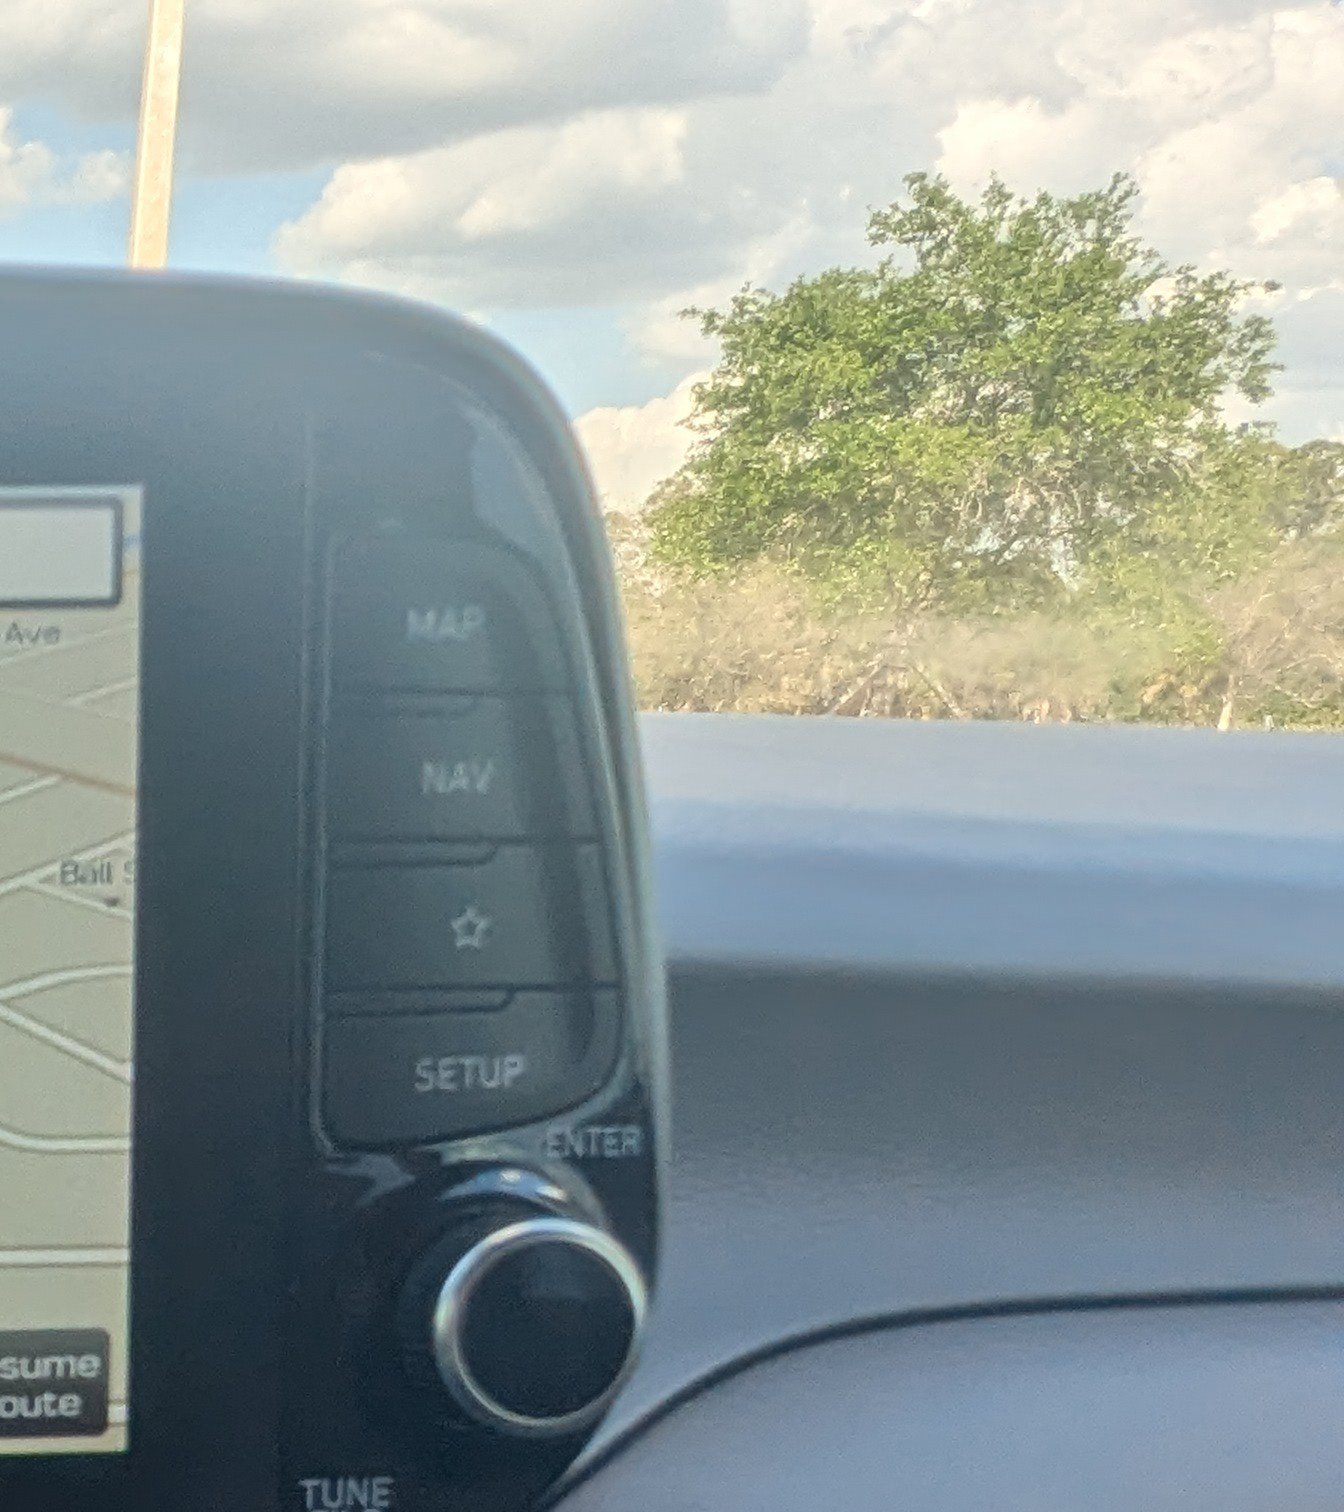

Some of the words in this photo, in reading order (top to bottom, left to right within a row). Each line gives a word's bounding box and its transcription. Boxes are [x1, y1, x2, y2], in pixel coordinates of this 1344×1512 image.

[5, 621, 60, 646] Ave
[407, 607, 485, 642] MAP
[420, 760, 495, 795] NAV
[413, 1056, 526, 1093] SETUP
[546, 1125, 641, 1158] ENTER
[298, 1475, 395, 1510] TUNE
